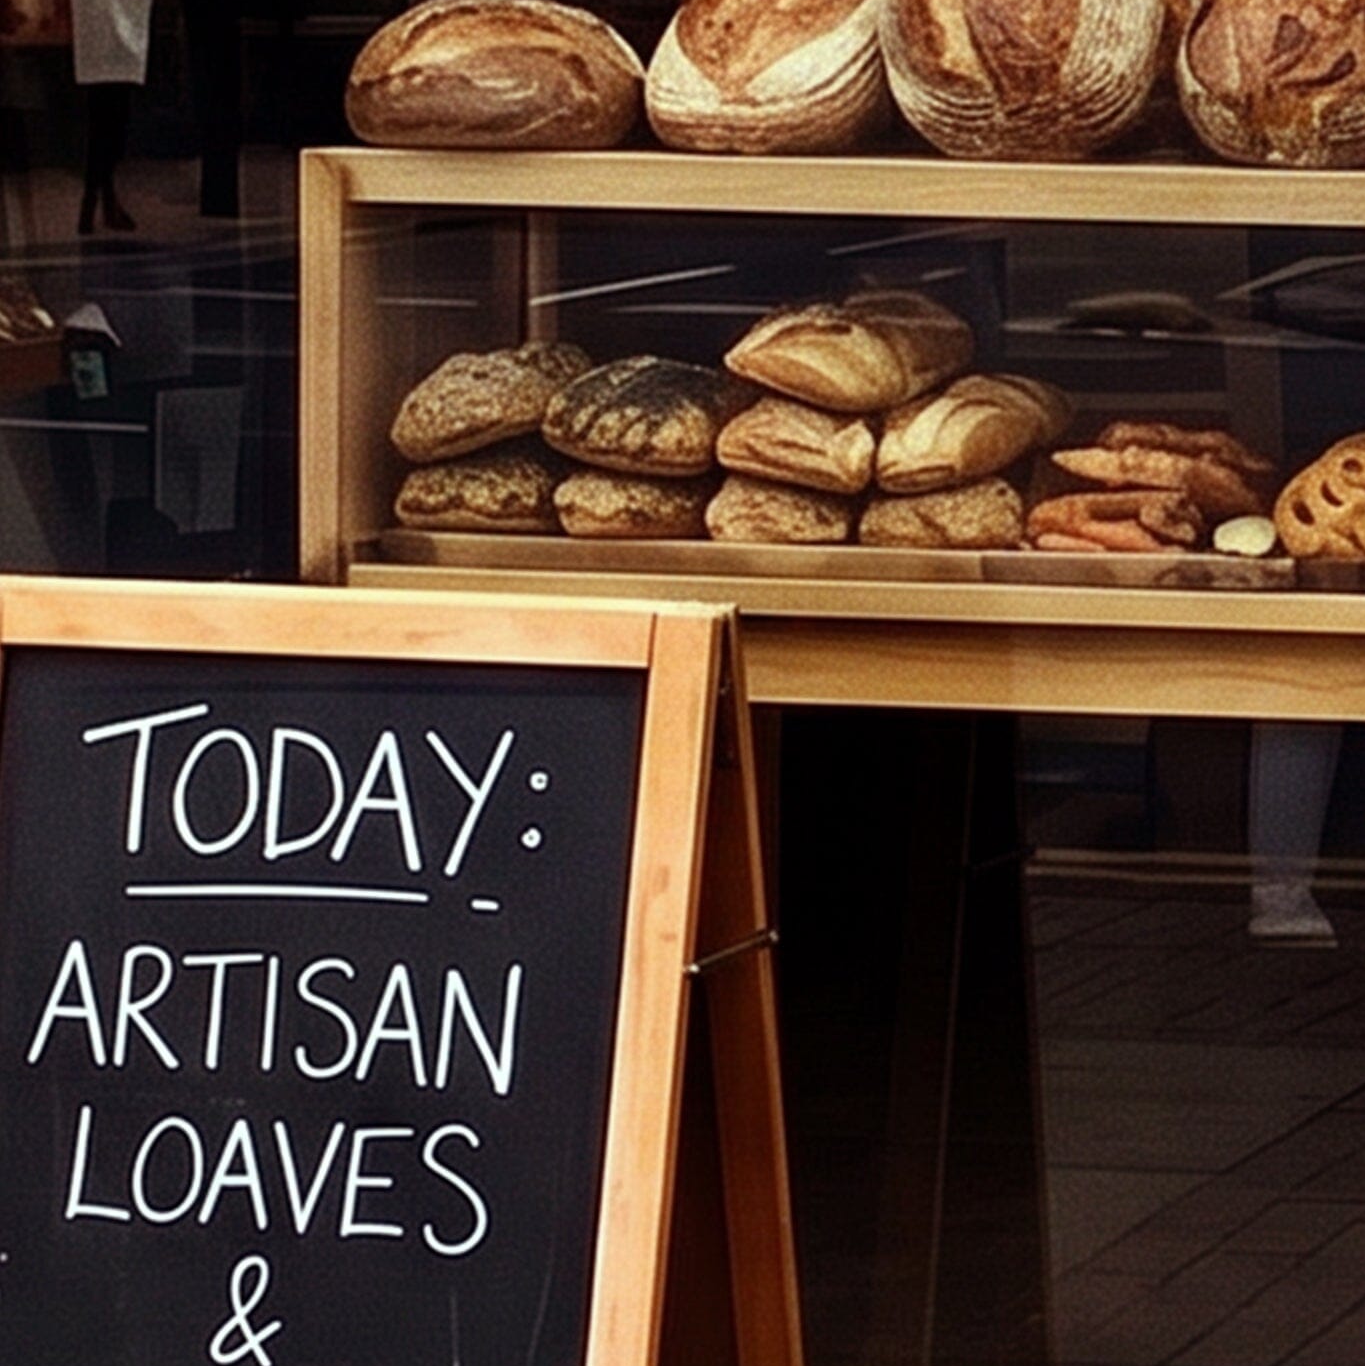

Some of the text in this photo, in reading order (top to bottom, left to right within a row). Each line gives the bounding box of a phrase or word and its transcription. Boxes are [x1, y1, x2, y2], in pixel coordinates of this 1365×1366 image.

[84, 705, 547, 875] TODAY:
[29, 941, 521, 1094] ARTISAN
[66, 1107, 486, 1254] LOAVES
[211, 1257, 280, 1366] &
